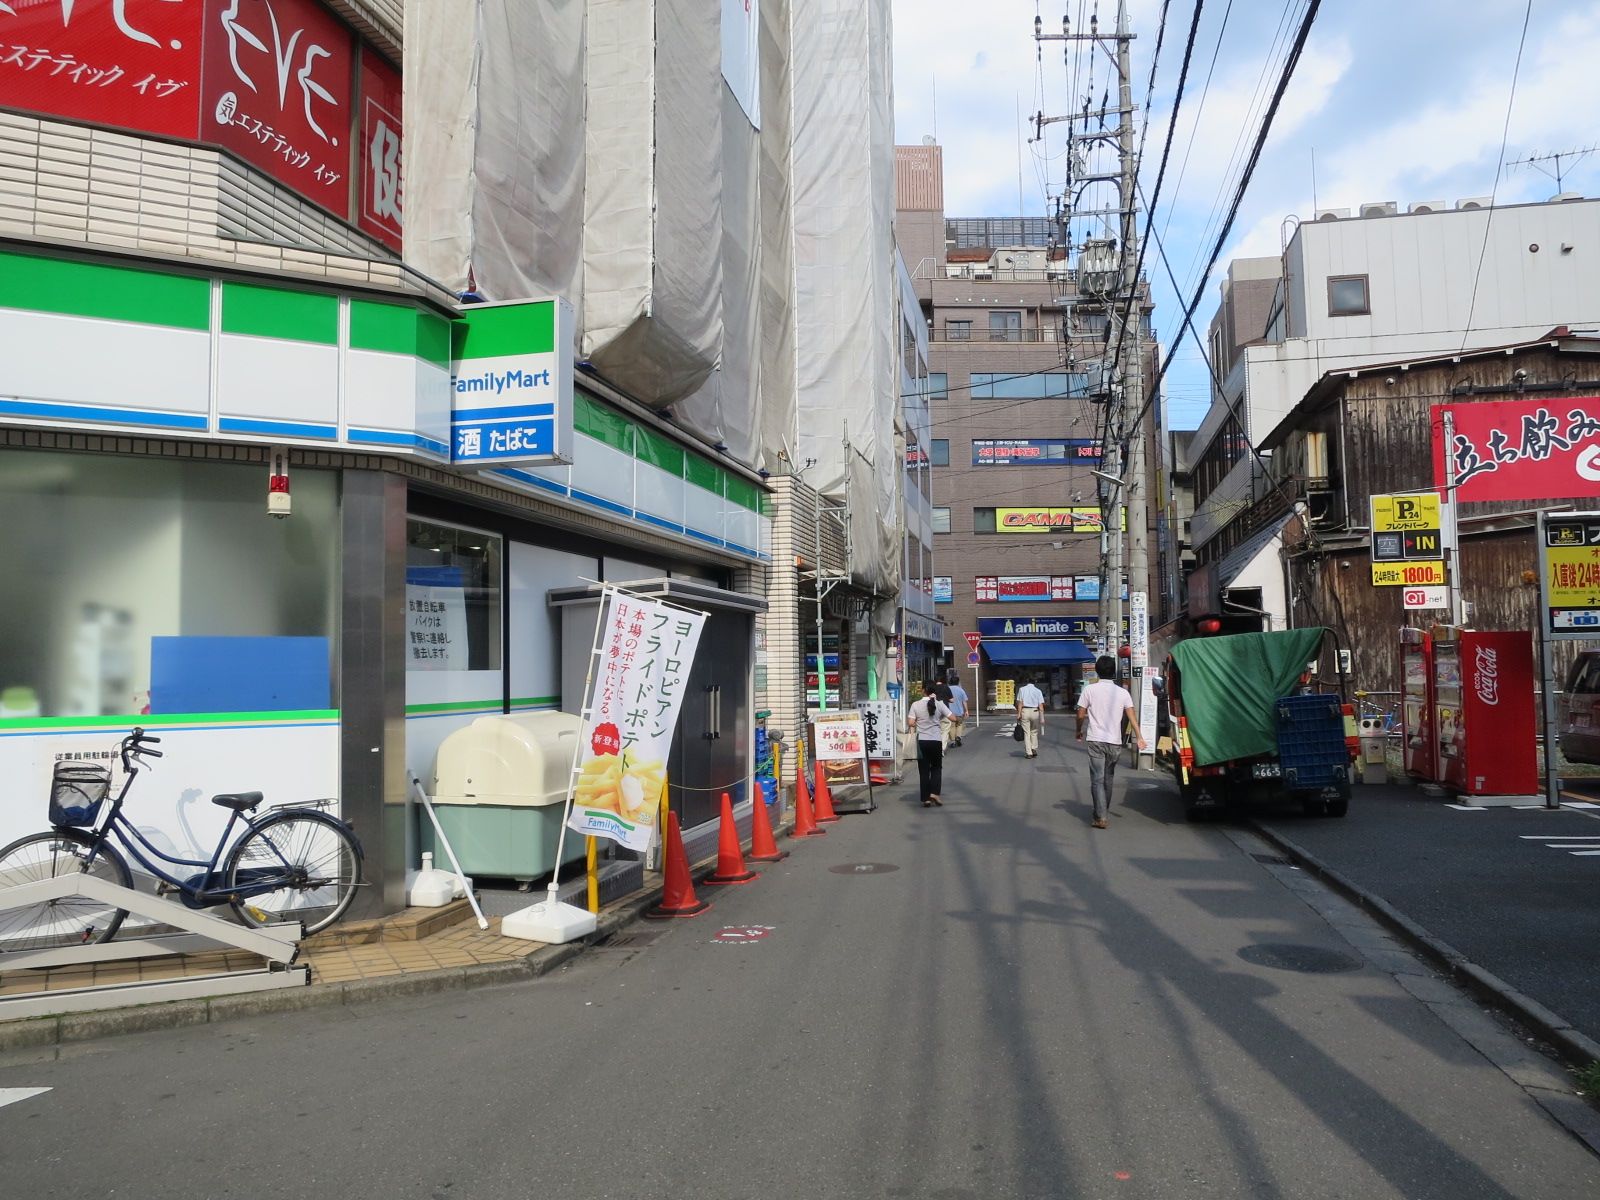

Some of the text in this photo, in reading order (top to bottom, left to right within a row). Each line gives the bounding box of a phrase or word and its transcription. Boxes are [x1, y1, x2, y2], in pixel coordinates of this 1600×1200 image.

[0, 43, 189, 98] ステティック イヴ
[314, 163, 342, 186] イヴ
[458, 427, 538, 457] 酒 たばこ
[1386, 522, 1430, 530] フレンドパーク
[1416, 535, 1435, 550] IN
[1402, 566, 1441, 584] 1800円
[415, 615, 442, 628] バイクは
[1015, 618, 1070, 634] animate
[410, 631, 452, 645] 警察に連絡し
[600, 602, 629, 720] 日本が夢中になる。
[650, 620, 693, 738] ヨーロピアン
[622, 612, 669, 773] フライドポテト
[588, 817, 627, 839] FamilyMart
